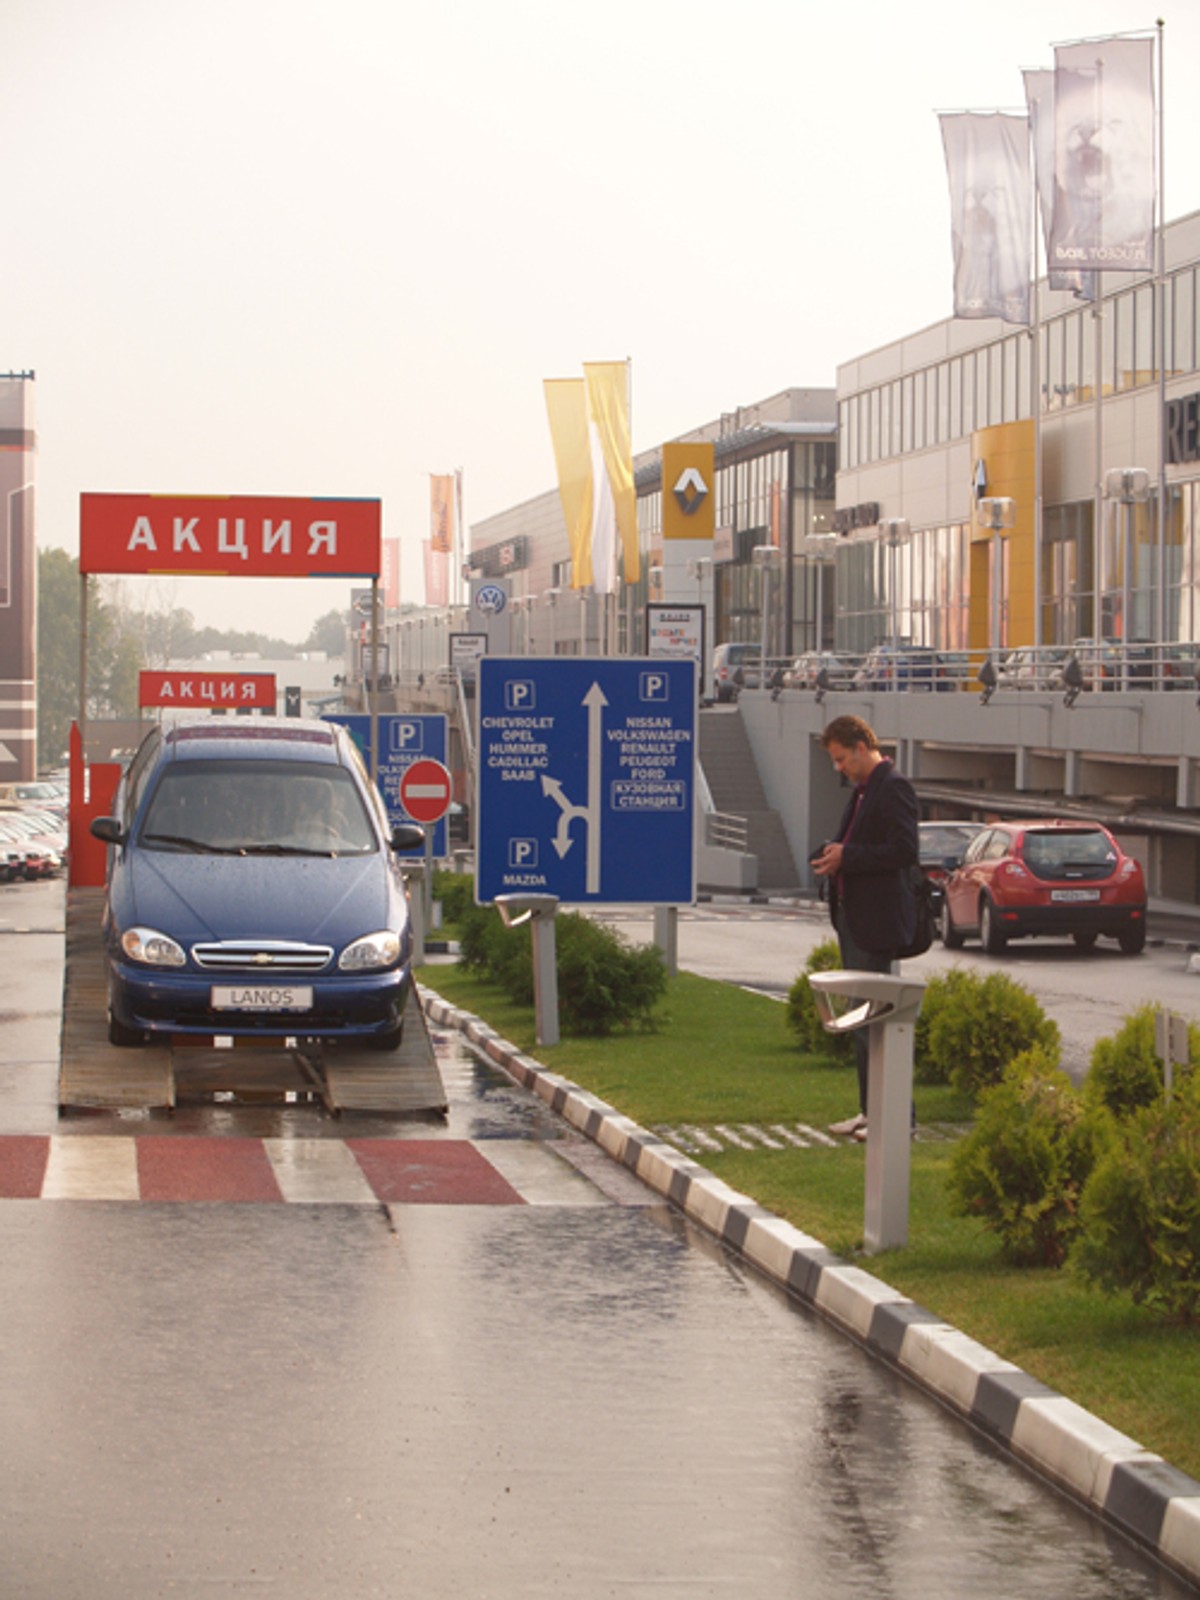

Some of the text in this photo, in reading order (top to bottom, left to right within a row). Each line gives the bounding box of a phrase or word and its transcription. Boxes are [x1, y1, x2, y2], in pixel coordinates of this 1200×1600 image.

[126, 516, 338, 560] АКЦИЯ
[160, 681, 256, 701] АКЦИЯ
[647, 675, 662, 698] P
[512, 683, 528, 707] P
[482, 716, 555, 729] CHEVROLET
[626, 717, 673, 728] NISSAN
[399, 723, 416, 748] P
[502, 730, 535, 742] OPEL
[607, 729, 692, 741] VOLKSWAGEN
[489, 743, 549, 755] HUMMER
[621, 743, 677, 754] RENAULT
[487, 755, 549, 768] CADILLAC
[619, 756, 677, 767] PEUGEOT
[501, 769, 536, 781] SAAB
[631, 768, 666, 779] FORD
[615, 783, 681, 794] КУЗОВНАЯ
[619, 796, 678, 808] СТАНЦИЯ
[516, 841, 531, 865] P
[503, 875, 546, 886] MAZDA
[230, 989, 295, 1005] LANOS
